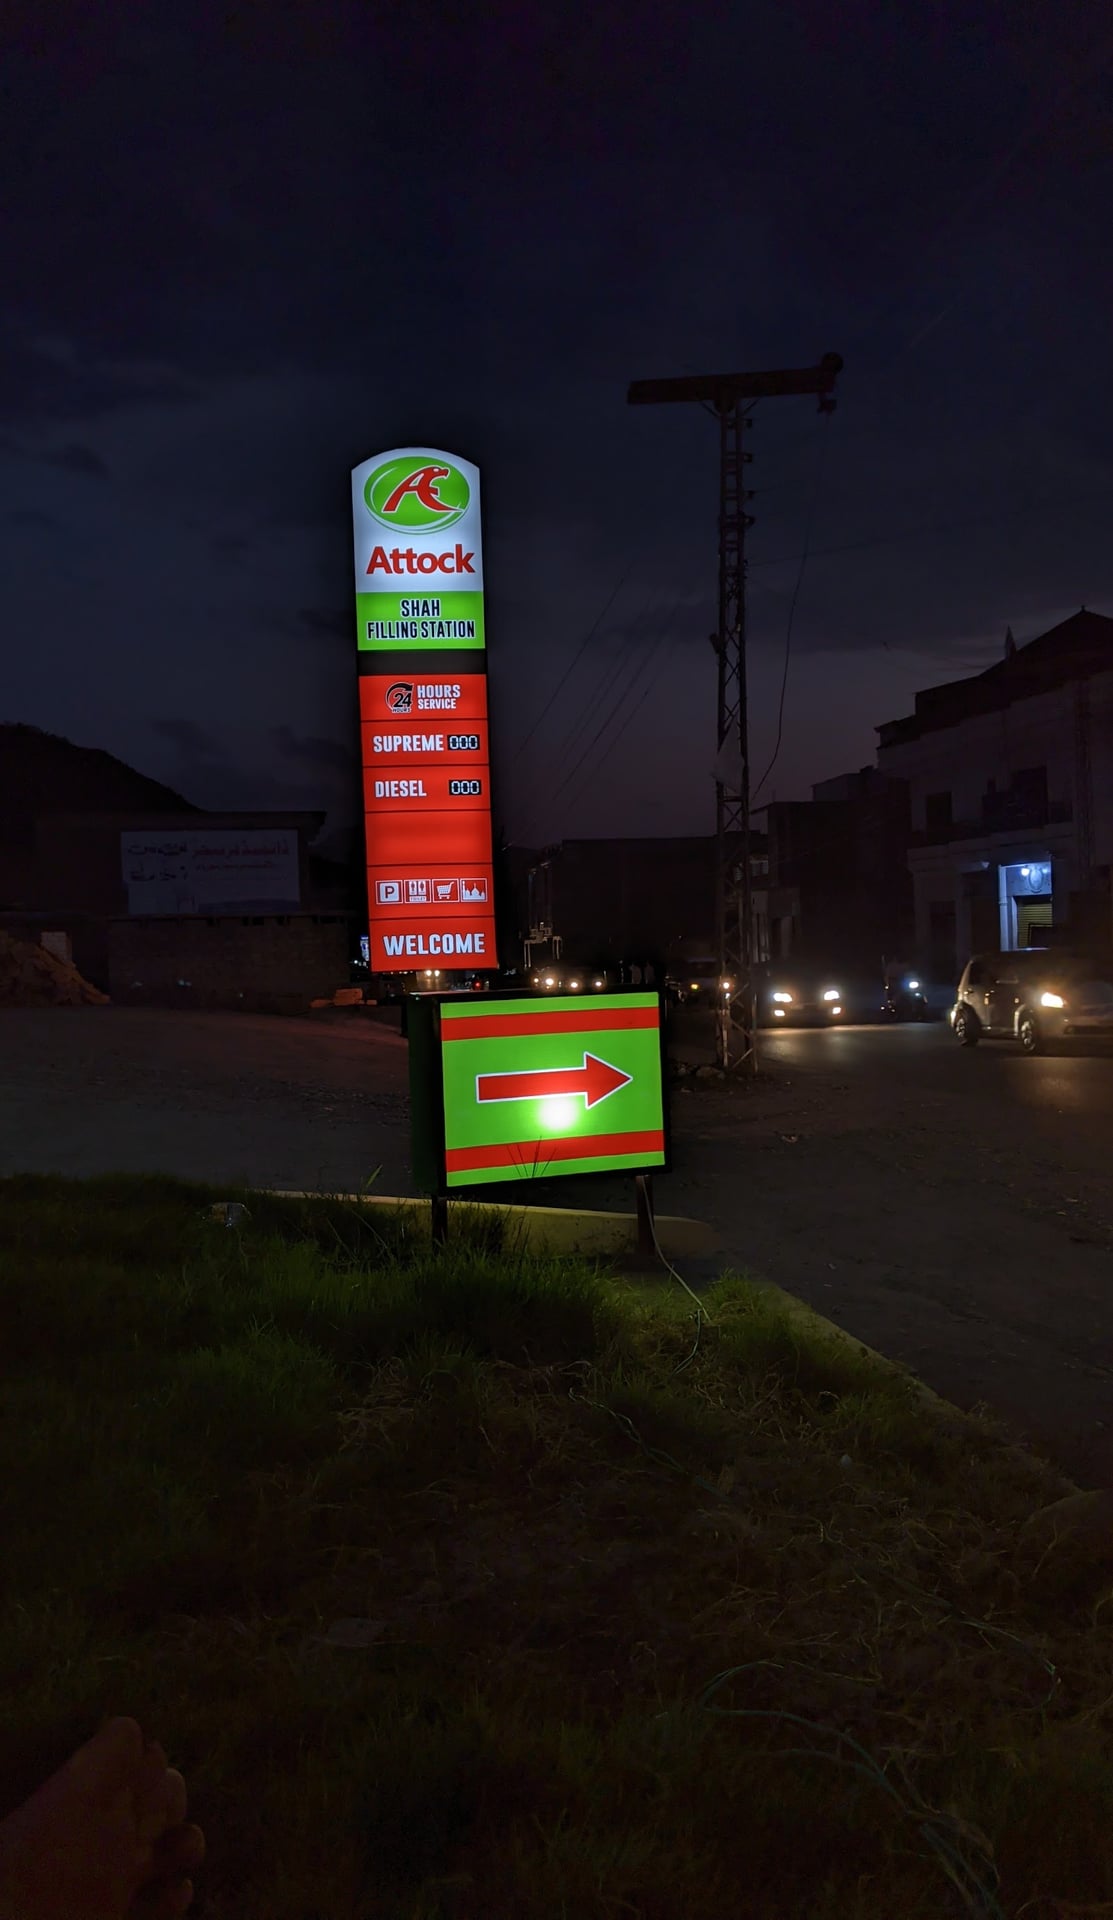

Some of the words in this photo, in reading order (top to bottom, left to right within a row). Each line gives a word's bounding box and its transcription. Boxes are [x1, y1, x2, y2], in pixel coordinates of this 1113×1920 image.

[366, 544, 476, 575] Attock
[400, 599, 441, 618] SHAH
[367, 621, 418, 640] FILLING
[421, 620, 475, 638] STATION
[393, 692, 412, 708] 24
[417, 684, 461, 698] HOURS
[417, 698, 457, 710] SERVICE
[373, 734, 444, 753] SUPREME
[449, 735, 478, 750] 000
[375, 780, 427, 798] DIESEL
[451, 780, 480, 795] 000
[384, 885, 395, 899] P
[383, 933, 485, 956] WELCOME
